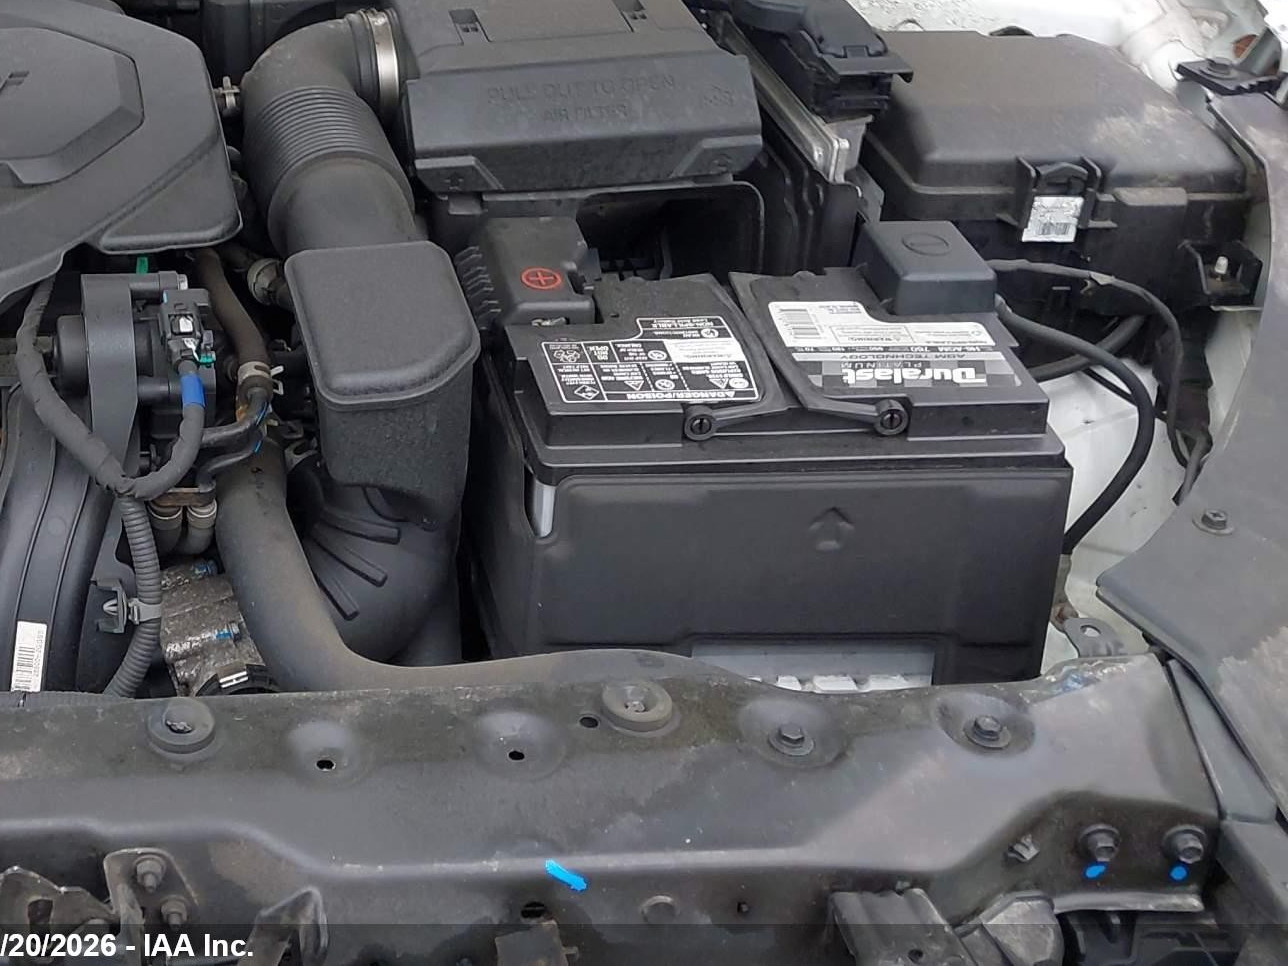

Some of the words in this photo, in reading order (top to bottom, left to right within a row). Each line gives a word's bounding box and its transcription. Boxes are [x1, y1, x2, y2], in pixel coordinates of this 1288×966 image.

[488, 84, 536, 105] PULL
[543, 81, 586, 99] OUT
[590, 79, 617, 96] TO
[620, 73, 675, 93] OPEN
[543, 107, 570, 122] AIR
[573, 104, 629, 121] FILTER
[840, 361, 922, 369] PLATINUM
[841, 367, 987, 384] Duralast
